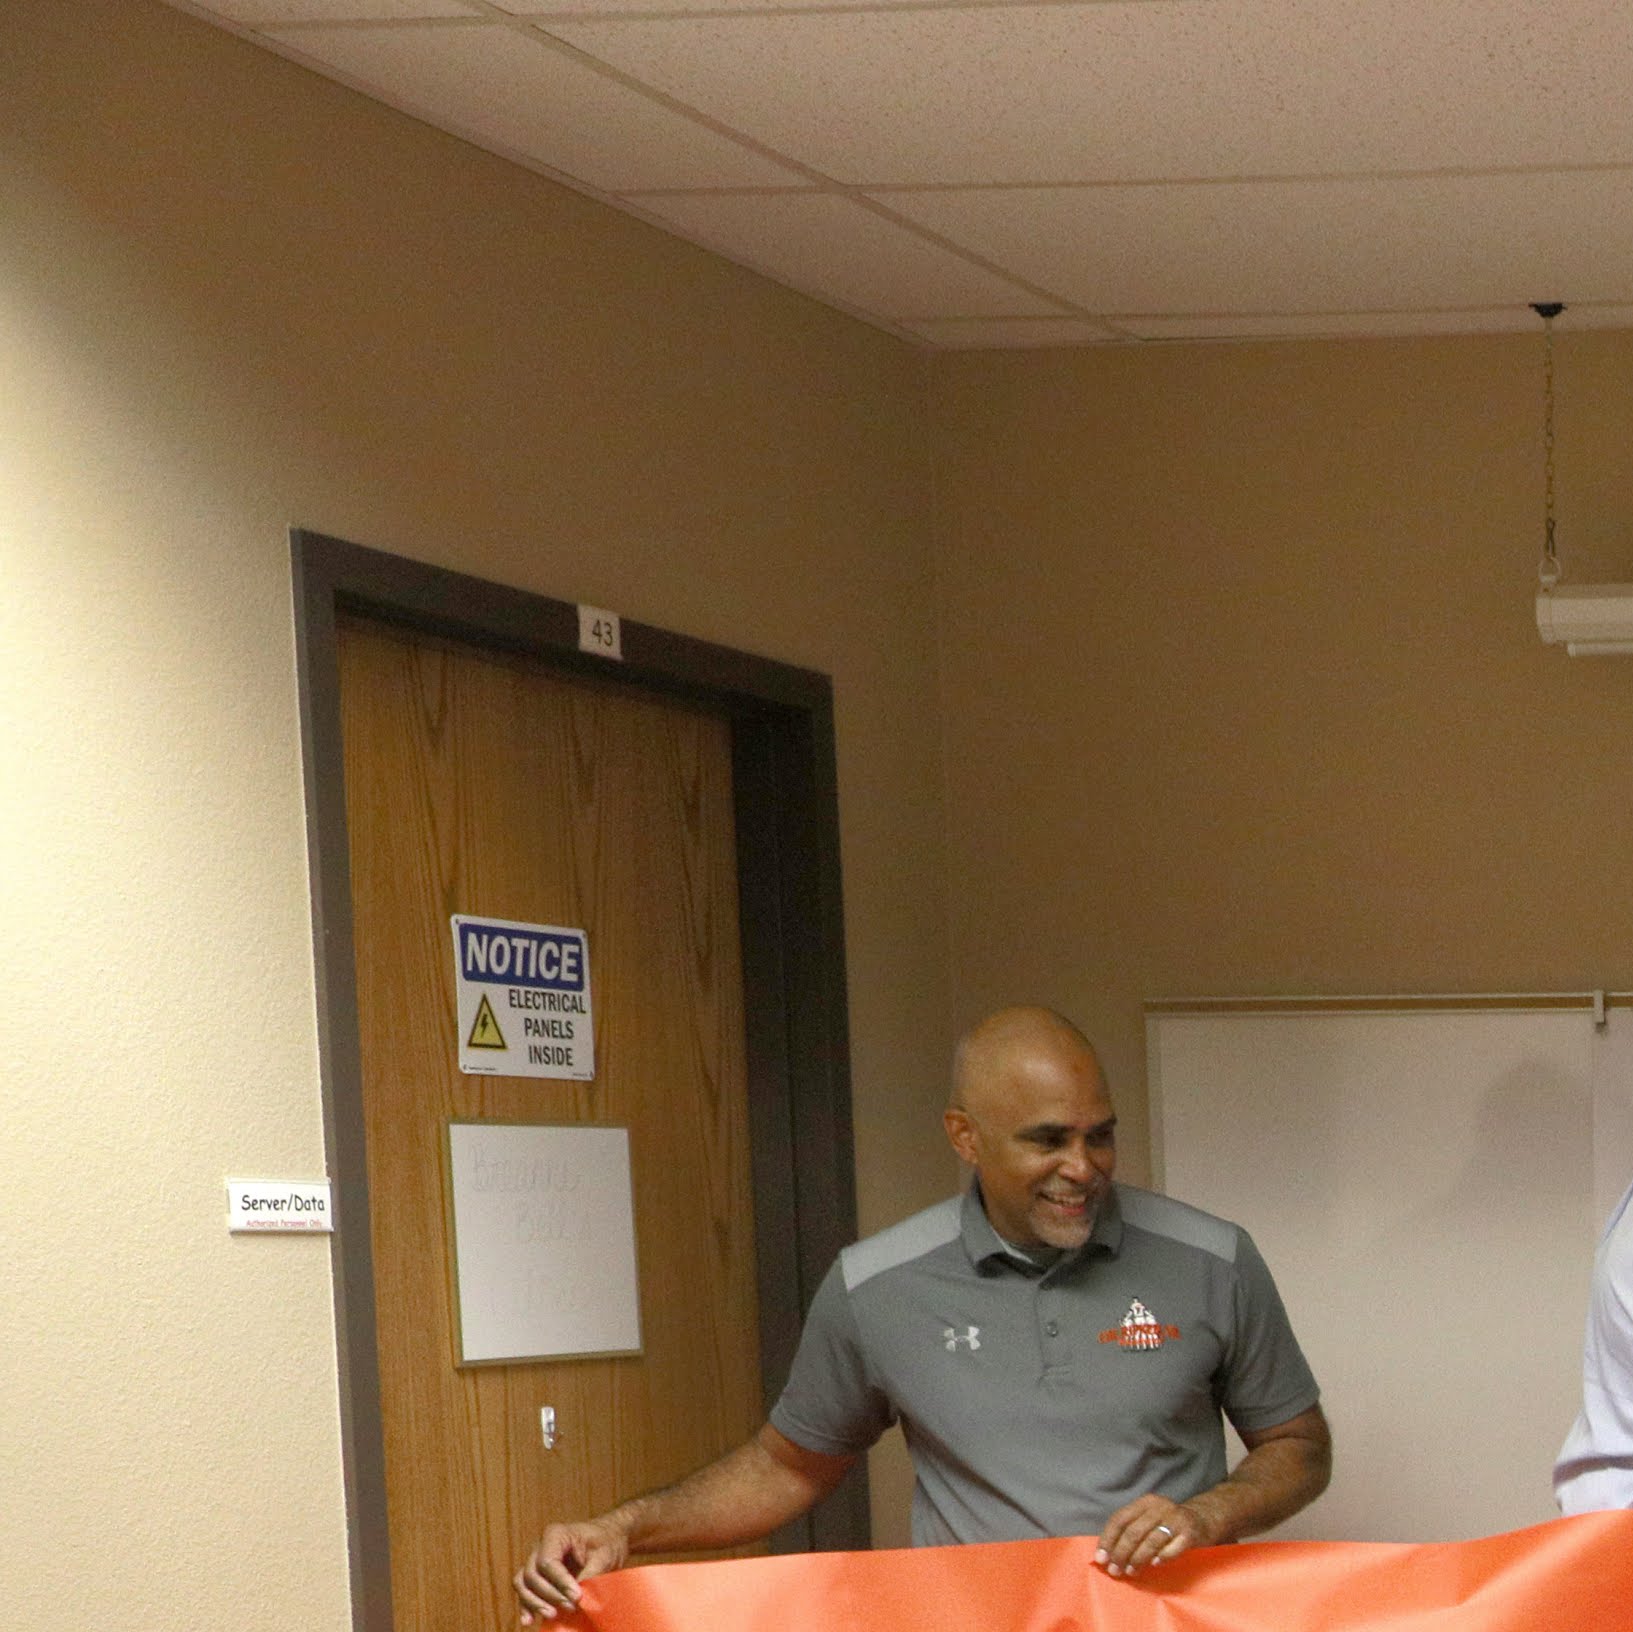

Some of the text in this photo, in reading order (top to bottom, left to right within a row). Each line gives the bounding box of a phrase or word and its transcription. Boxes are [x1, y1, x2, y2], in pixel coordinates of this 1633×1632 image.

[592, 619, 613, 647] 43
[467, 932, 580, 982] NOTICE
[509, 989, 586, 1014] ELECTRICAL
[524, 1017, 574, 1039] PANELS
[529, 1045, 573, 1066] INSIDE
[241, 1193, 325, 1211] Server/Data
